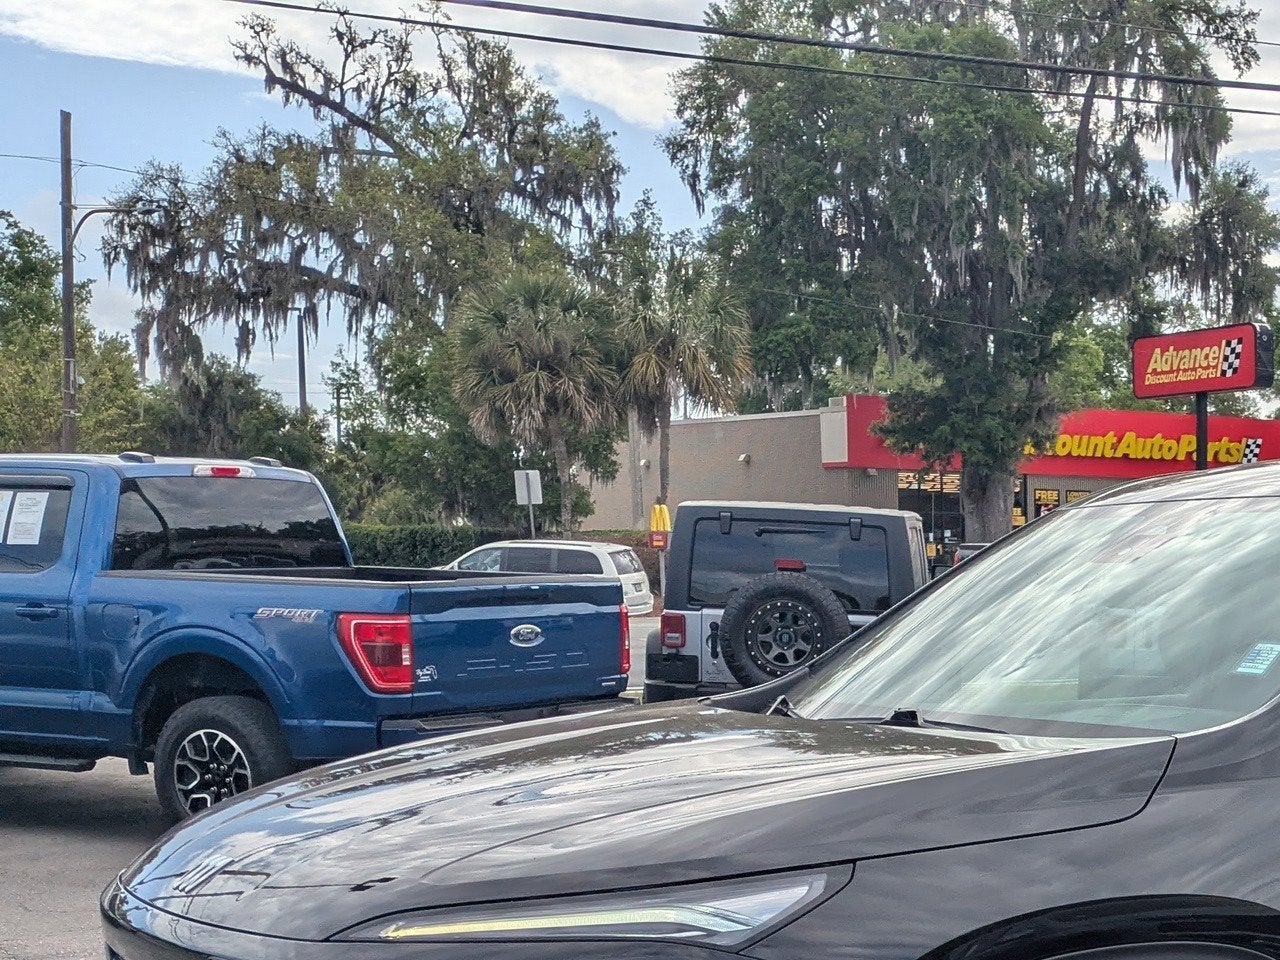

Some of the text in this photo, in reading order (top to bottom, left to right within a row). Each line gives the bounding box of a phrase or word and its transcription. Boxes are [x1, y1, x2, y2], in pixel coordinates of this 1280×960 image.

[1147, 345, 1219, 373] Advance
[1144, 367, 1217, 386] Discount Auto Parts
[1177, 434, 1240, 463] Prts
[1035, 490, 1059, 500] FREE
[253, 607, 324, 619] SPORT
